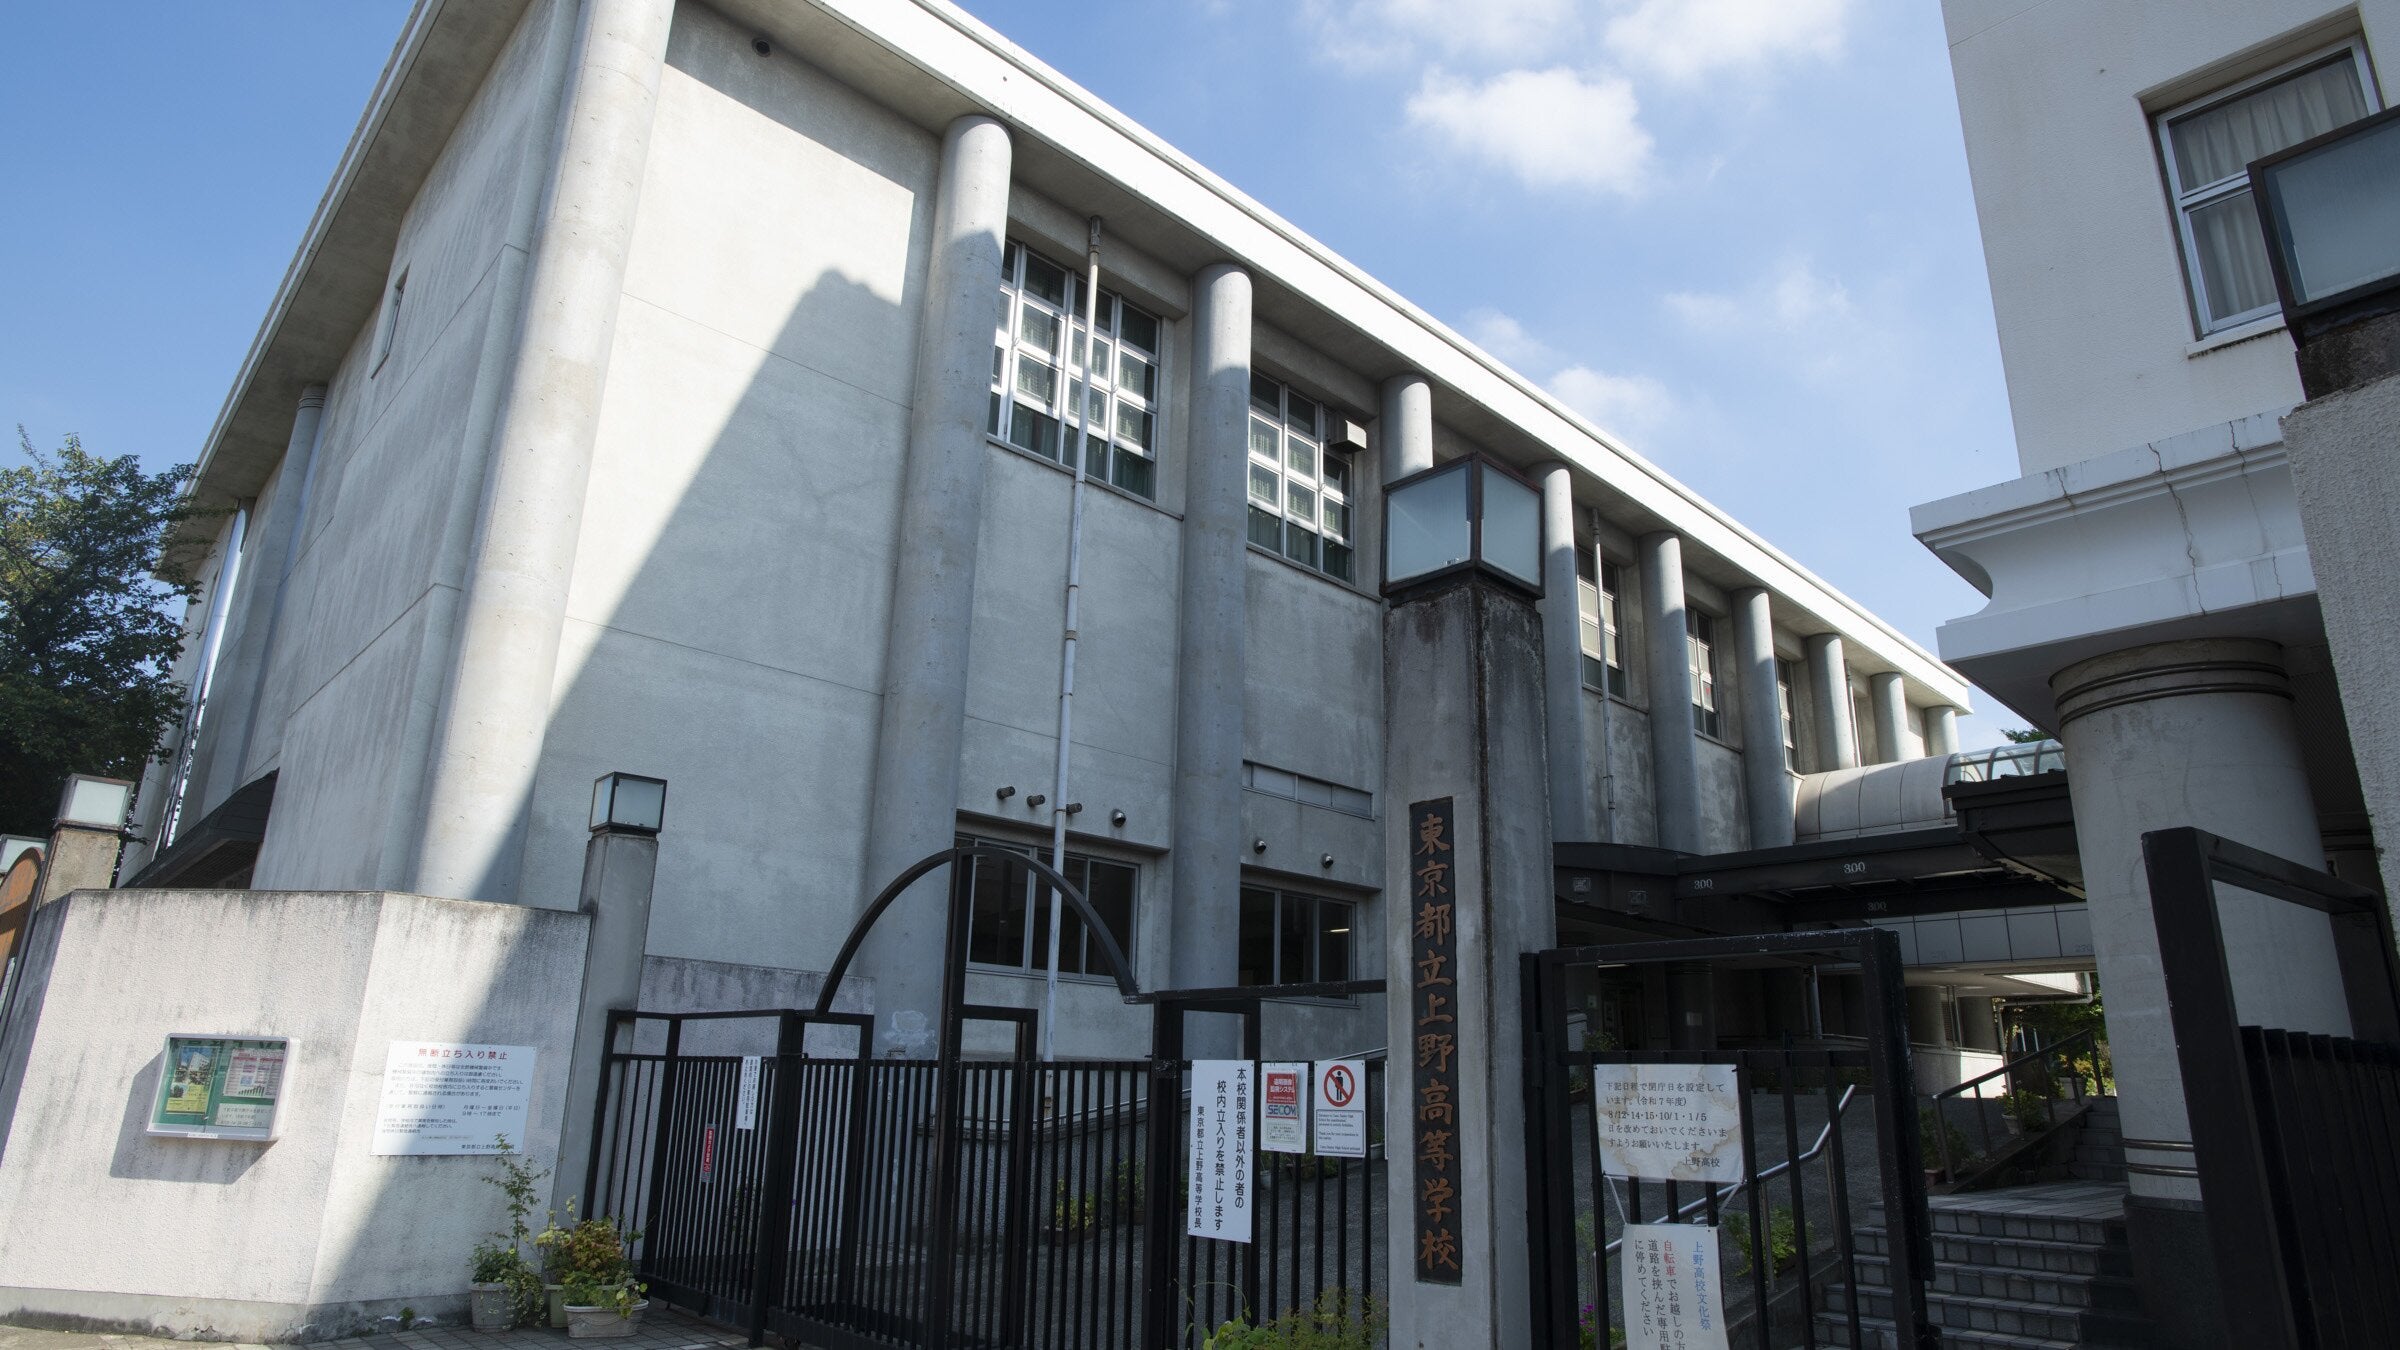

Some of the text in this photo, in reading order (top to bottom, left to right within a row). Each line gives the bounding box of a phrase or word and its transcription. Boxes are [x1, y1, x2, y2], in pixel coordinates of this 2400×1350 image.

[1843, 862, 1866, 874] 300
[1693, 878, 1713, 890] 300
[1413, 812, 1460, 1273] 東京都立上野高等学校
[417, 1047, 509, 1061] 無断立ち入り禁止
[1605, 1082, 1726, 1093] 下記日程で閉庁日を設定して
[1267, 1104, 1297, 1116] SECOM
[1234, 1067, 1247, 1209] 本校関係者以外の者の
[1608, 1125, 1729, 1138] 日を改めておいでくださいま
[1608, 1139, 1704, 1151] すようお願いいたします。
[1214, 1080, 1227, 1231] 校内立入りを禁止します
[1681, 1156, 1721, 1168] 上野高校
[1194, 1105, 1205, 1229] 東京都立上野高等学校長
[1634, 1239, 1655, 1337] に停めてください
[1692, 1241, 1712, 1331] 上野高校文化祭
